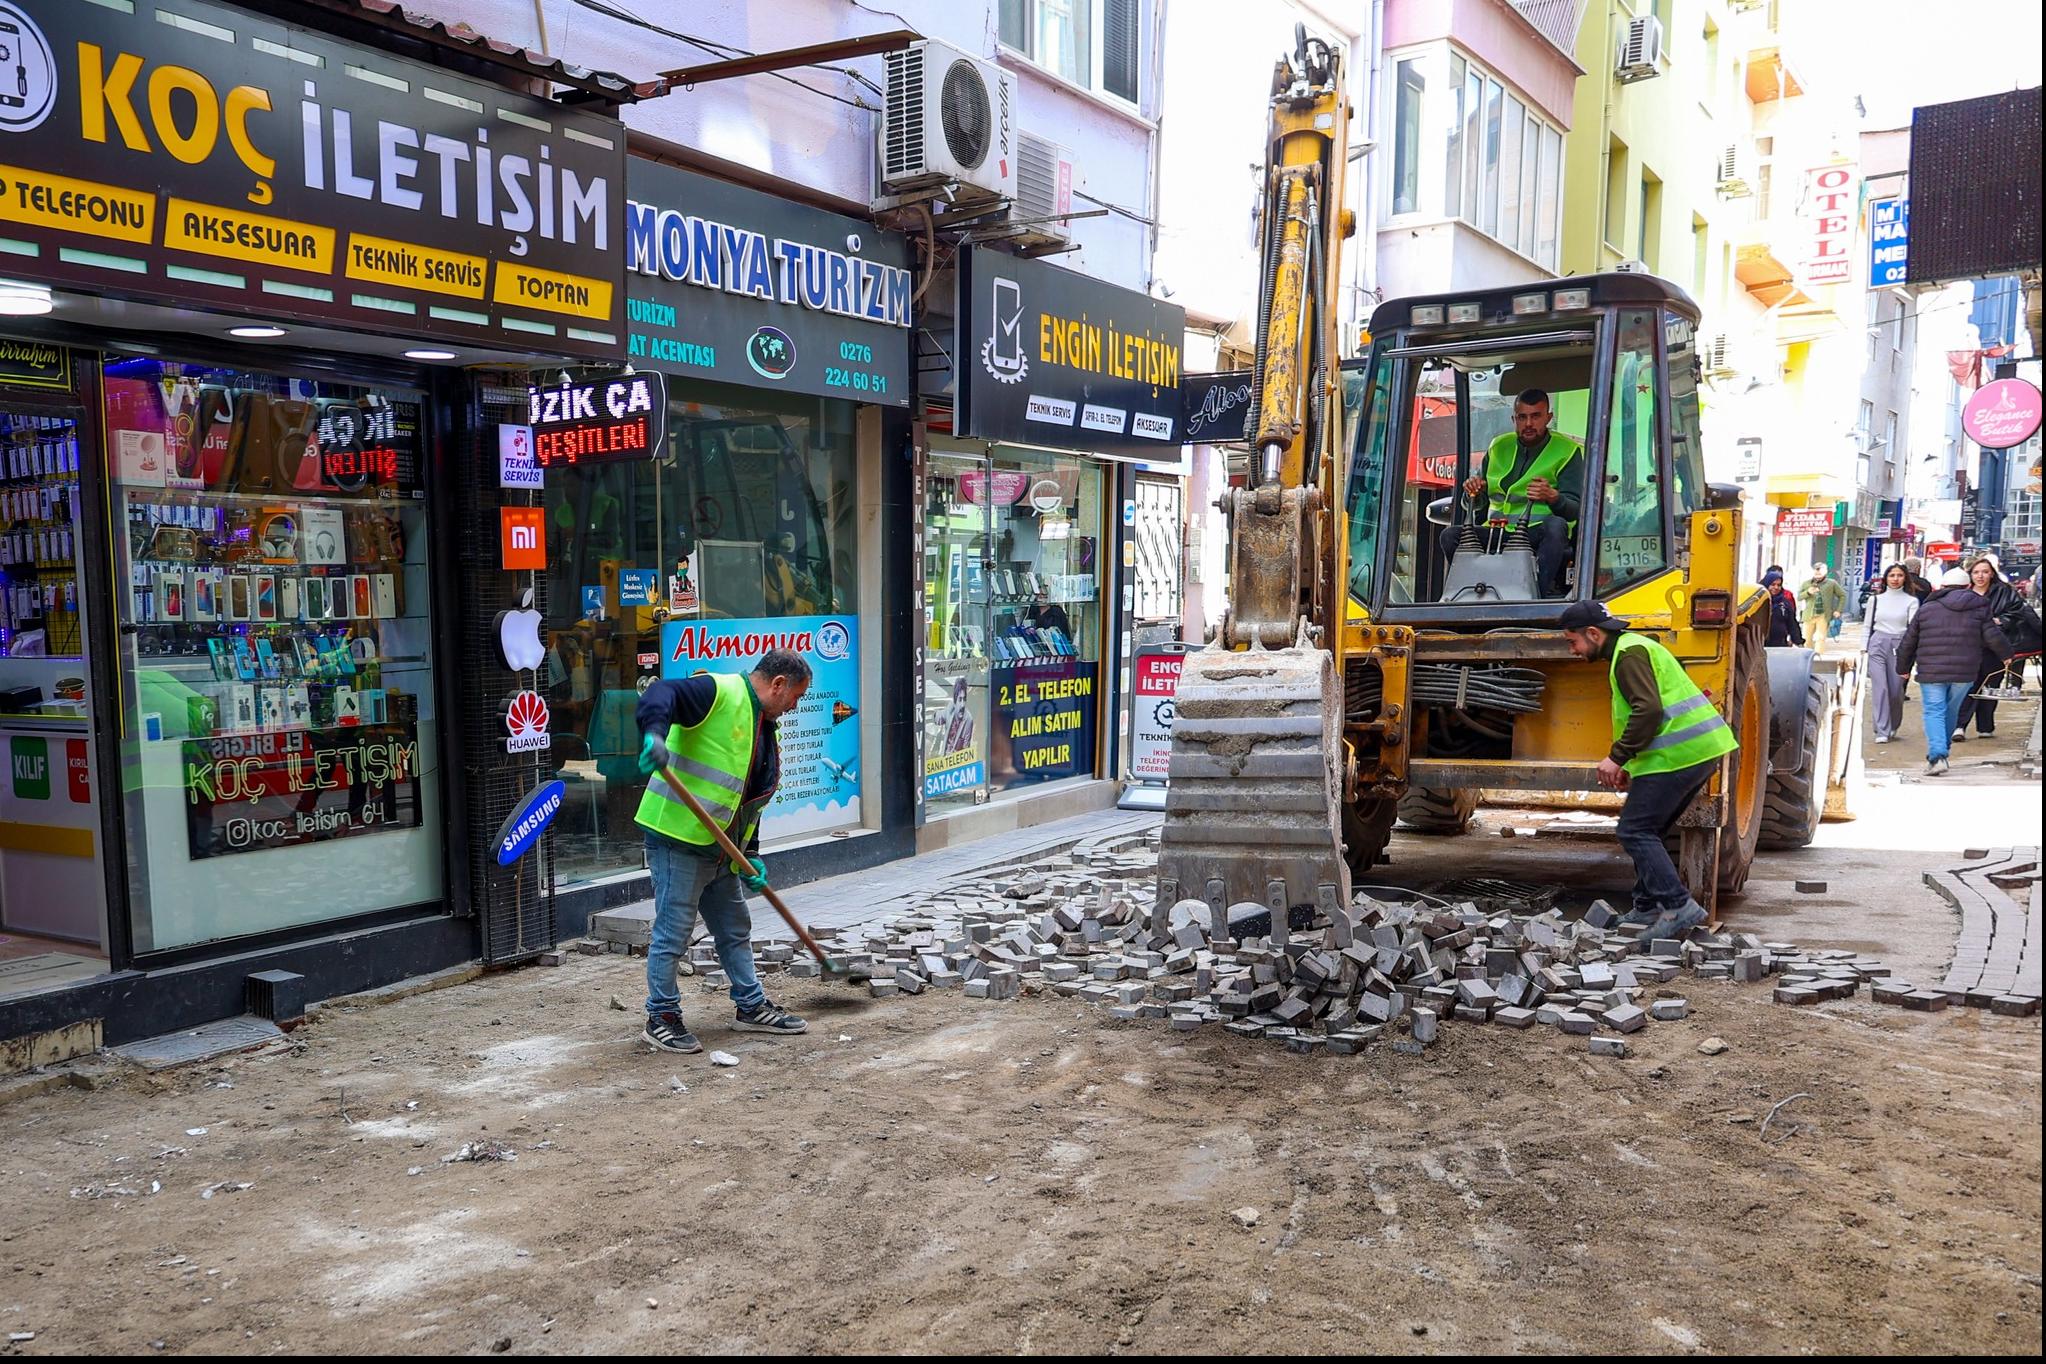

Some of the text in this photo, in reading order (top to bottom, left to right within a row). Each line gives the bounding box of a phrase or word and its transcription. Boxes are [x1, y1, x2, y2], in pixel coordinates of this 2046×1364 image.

[999, 75, 1010, 156] arçelik
[77, 41, 608, 256] KOÇ İLETİŞİM
[16, 181, 144, 229] TELEFONU
[1814, 170, 1849, 258] OTEL
[184, 213, 317, 259] AKSESUAR
[353, 244, 482, 288] TEKNİK SERVİS
[774, 234, 912, 327] TURİZM
[517, 275, 589, 307] TOPTAN
[651, 337, 715, 368] ACENTASI
[840, 341, 871, 363] 0276
[1040, 312, 1178, 399] ENGİN İLETİŞİM
[825, 367, 887, 393] 224 60 51
[606, 380, 651, 419] ÇA
[1030, 402, 1071, 419] TEKNİK SERVİS
[1136, 418, 1168, 435] AKSESUAR
[1973, 408, 2034, 425] Elegance
[1980, 421, 2024, 436] Butik
[536, 417, 646, 465] ÇEŞİTLERİ
[504, 469, 540, 482] SERVİS
[1604, 538, 1657, 552] 34 06
[1617, 553, 1650, 566] 13116
[914, 446, 923, 805] TEKNİK SERVİS
[673, 626, 812, 661] Akmonya
[1015, 685, 1031, 703] EL
[1038, 677, 1091, 701] TELEFON
[784, 730, 799, 739] DOĞU
[1011, 711, 1081, 738] ALIM SATIM
[509, 736, 548, 749] HUAWEI
[1023, 744, 1070, 769] YAPILIR
[14, 755, 45, 780] KILIF
[927, 750, 975, 774] SANA TELEFON
[189, 757, 265, 805] KOÇ
[927, 766, 977, 795] SATACAM
[503, 793, 560, 851] SAMSUNG
